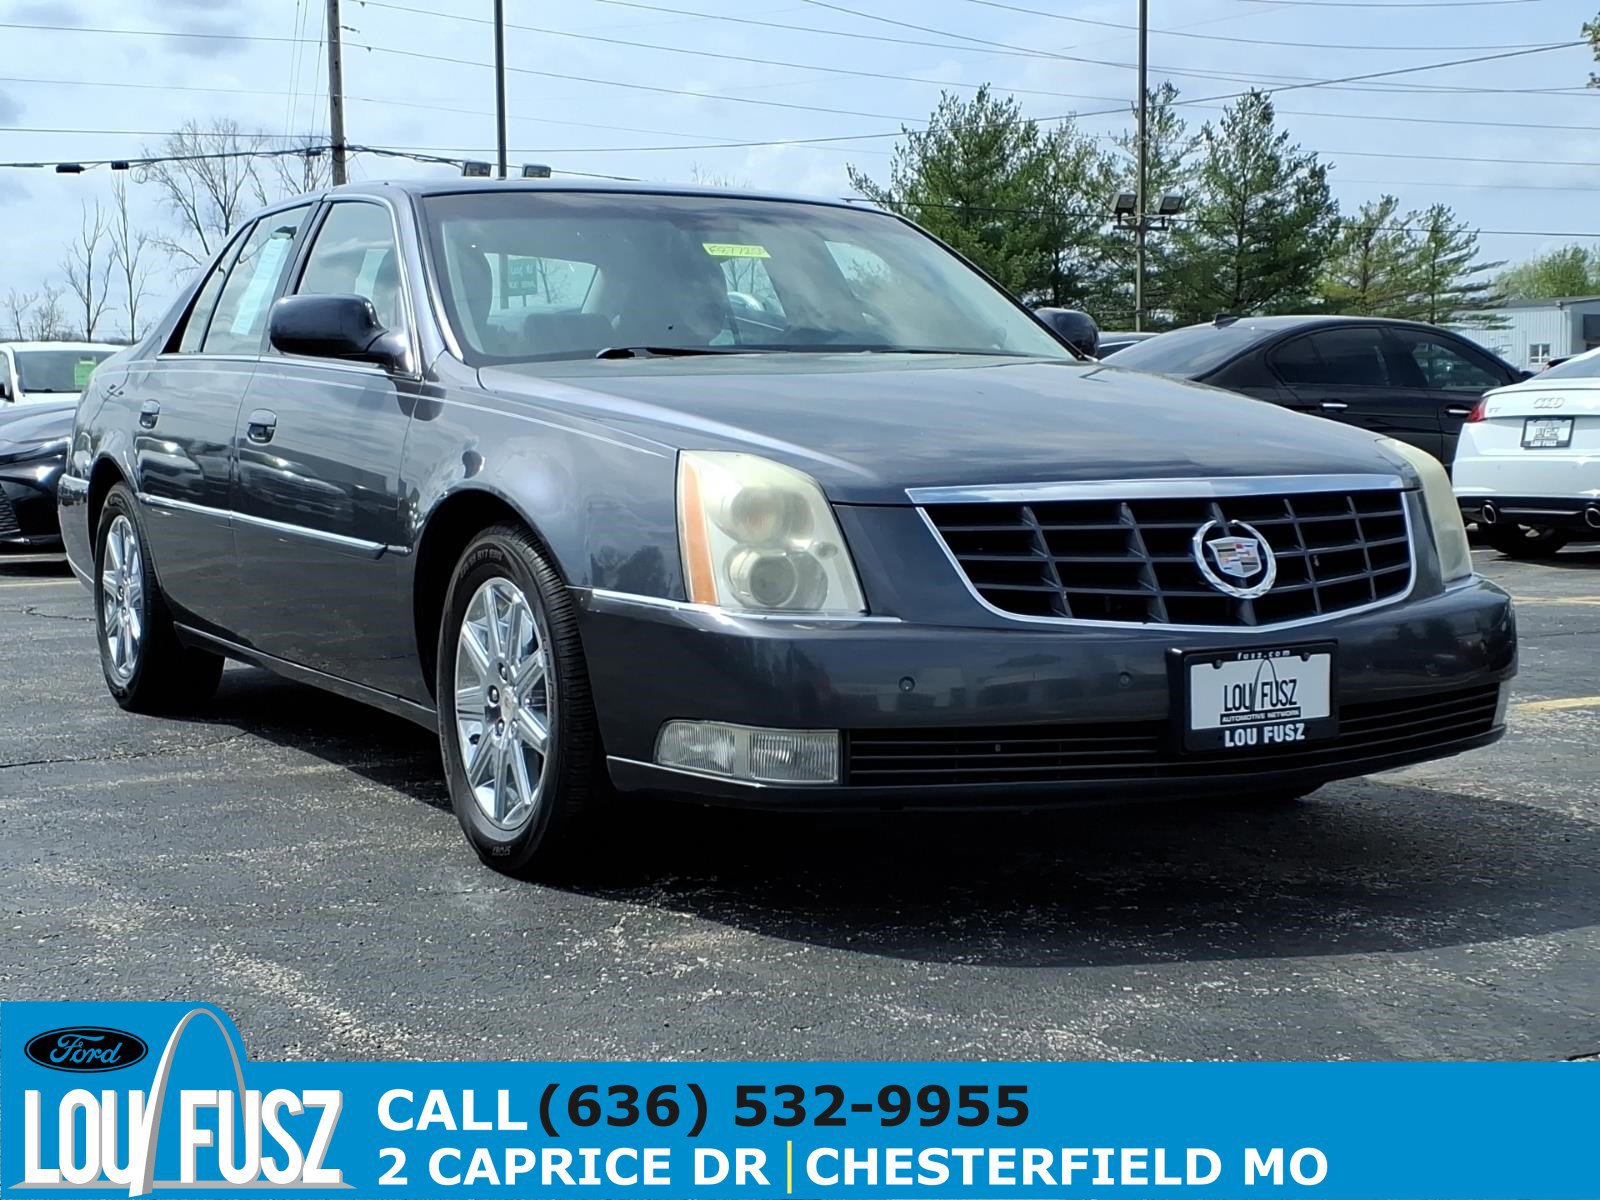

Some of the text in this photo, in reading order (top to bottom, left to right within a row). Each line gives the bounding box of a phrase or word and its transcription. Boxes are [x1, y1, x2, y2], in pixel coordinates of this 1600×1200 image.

[1237, 649, 1291, 661] fusz.com
[1224, 679, 1297, 713] LOU FUSZ
[1221, 709, 1301, 723] AUTOMOTIVE NETWORK
[1225, 723, 1306, 748] LOU FUSZ
